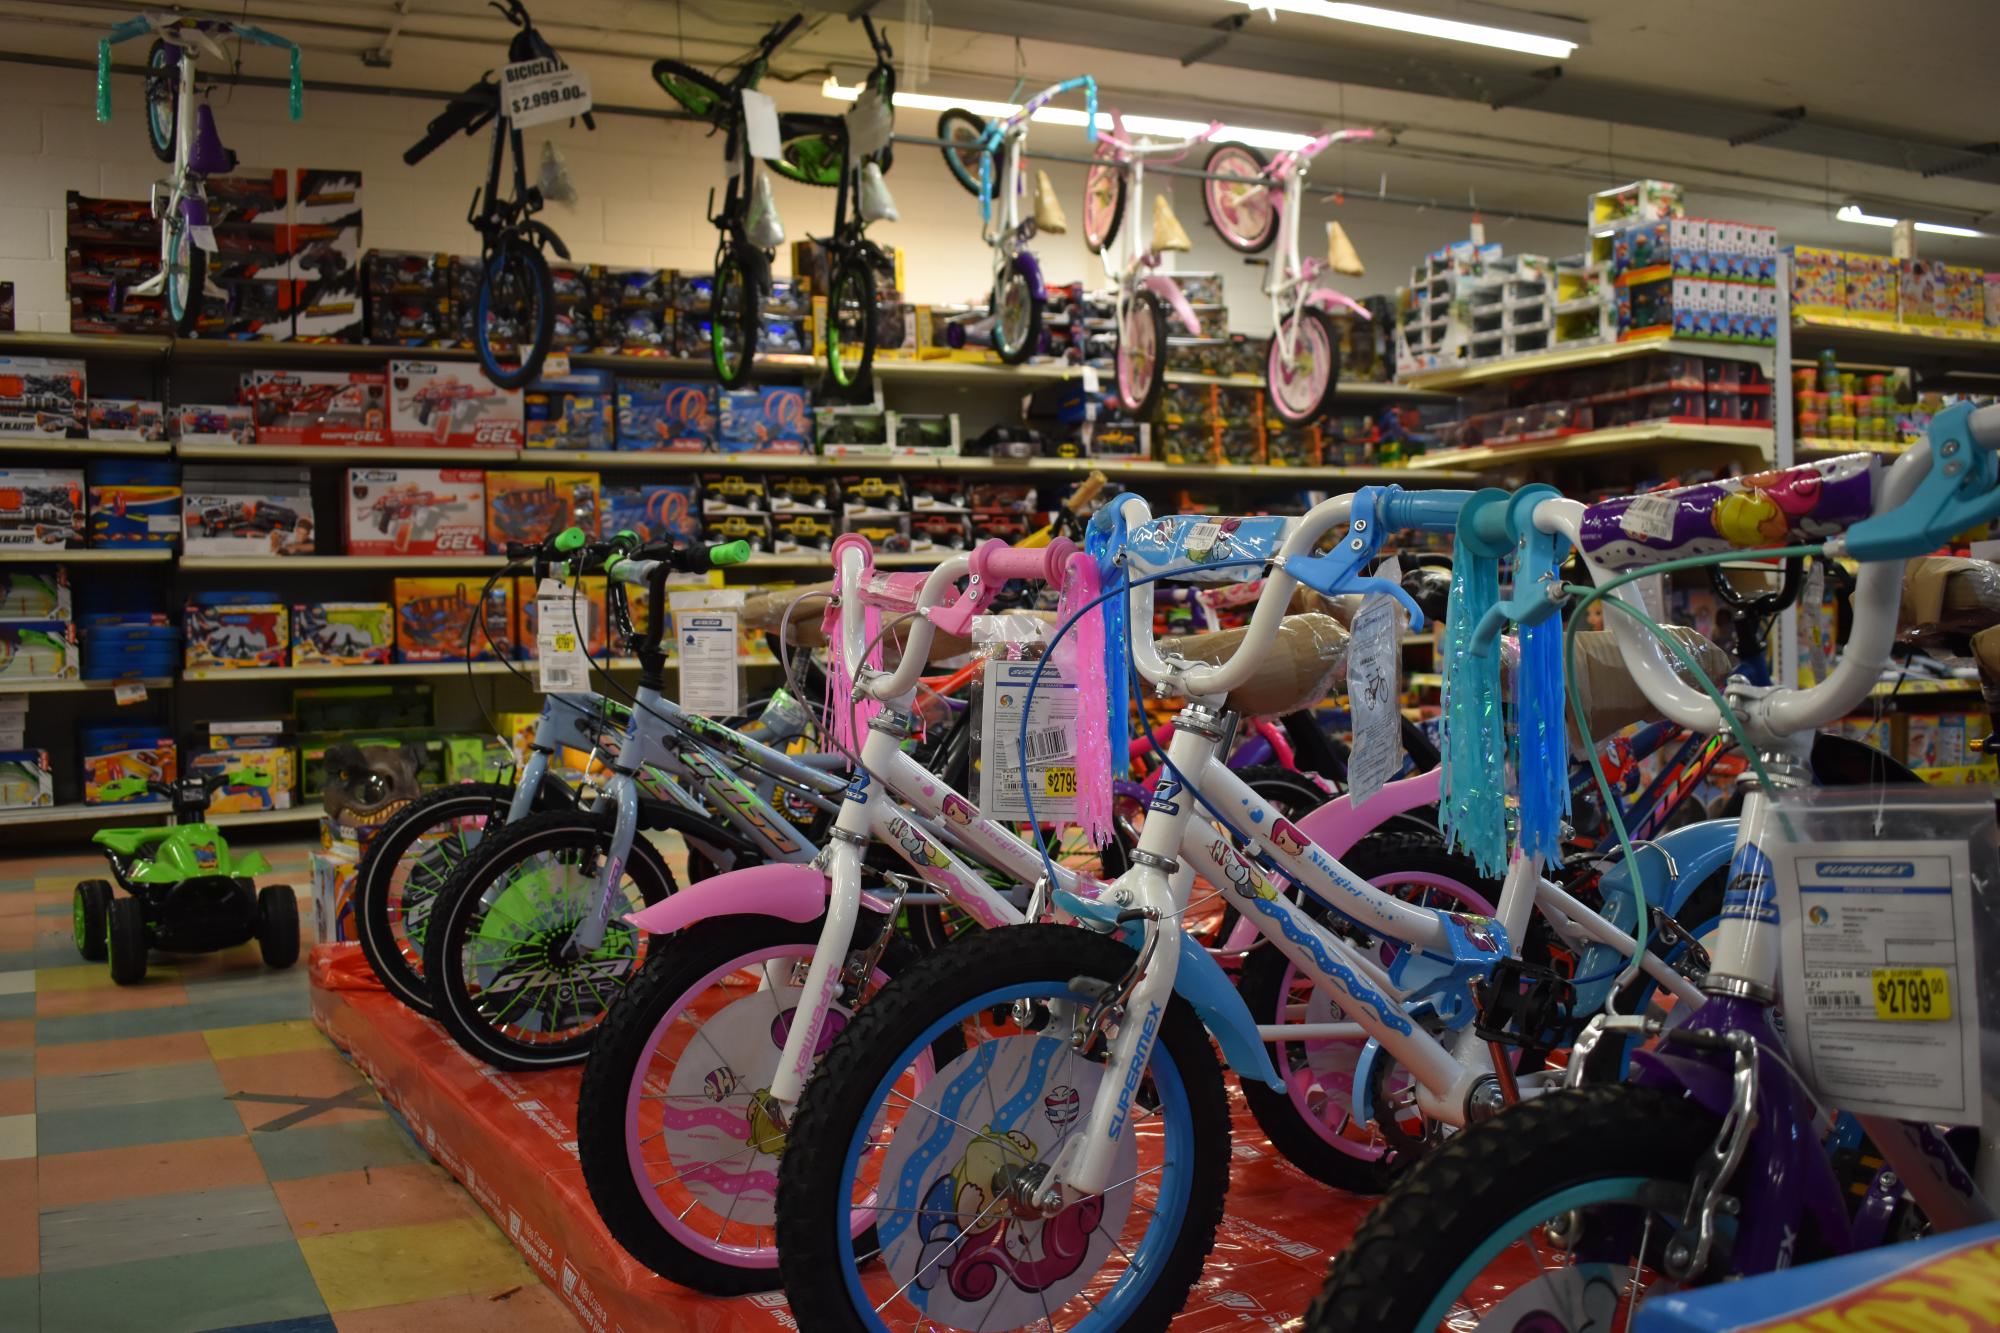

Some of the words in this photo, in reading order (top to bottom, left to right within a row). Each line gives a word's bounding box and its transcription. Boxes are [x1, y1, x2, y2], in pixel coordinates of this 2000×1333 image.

[505, 60, 569, 83] BICICLETA
[353, 431, 384, 442] GEL
[475, 429, 517, 443] GEL
[435, 535, 478, 550] GEL
[1309, 850, 1363, 897] Nicegirl
[1819, 864, 1908, 875] SUPERMEX
[1878, 978, 1932, 1014] $2799
[793, 963, 840, 1078] SUPERMEX
[1108, 1000, 1162, 1142] SUPERMEX
